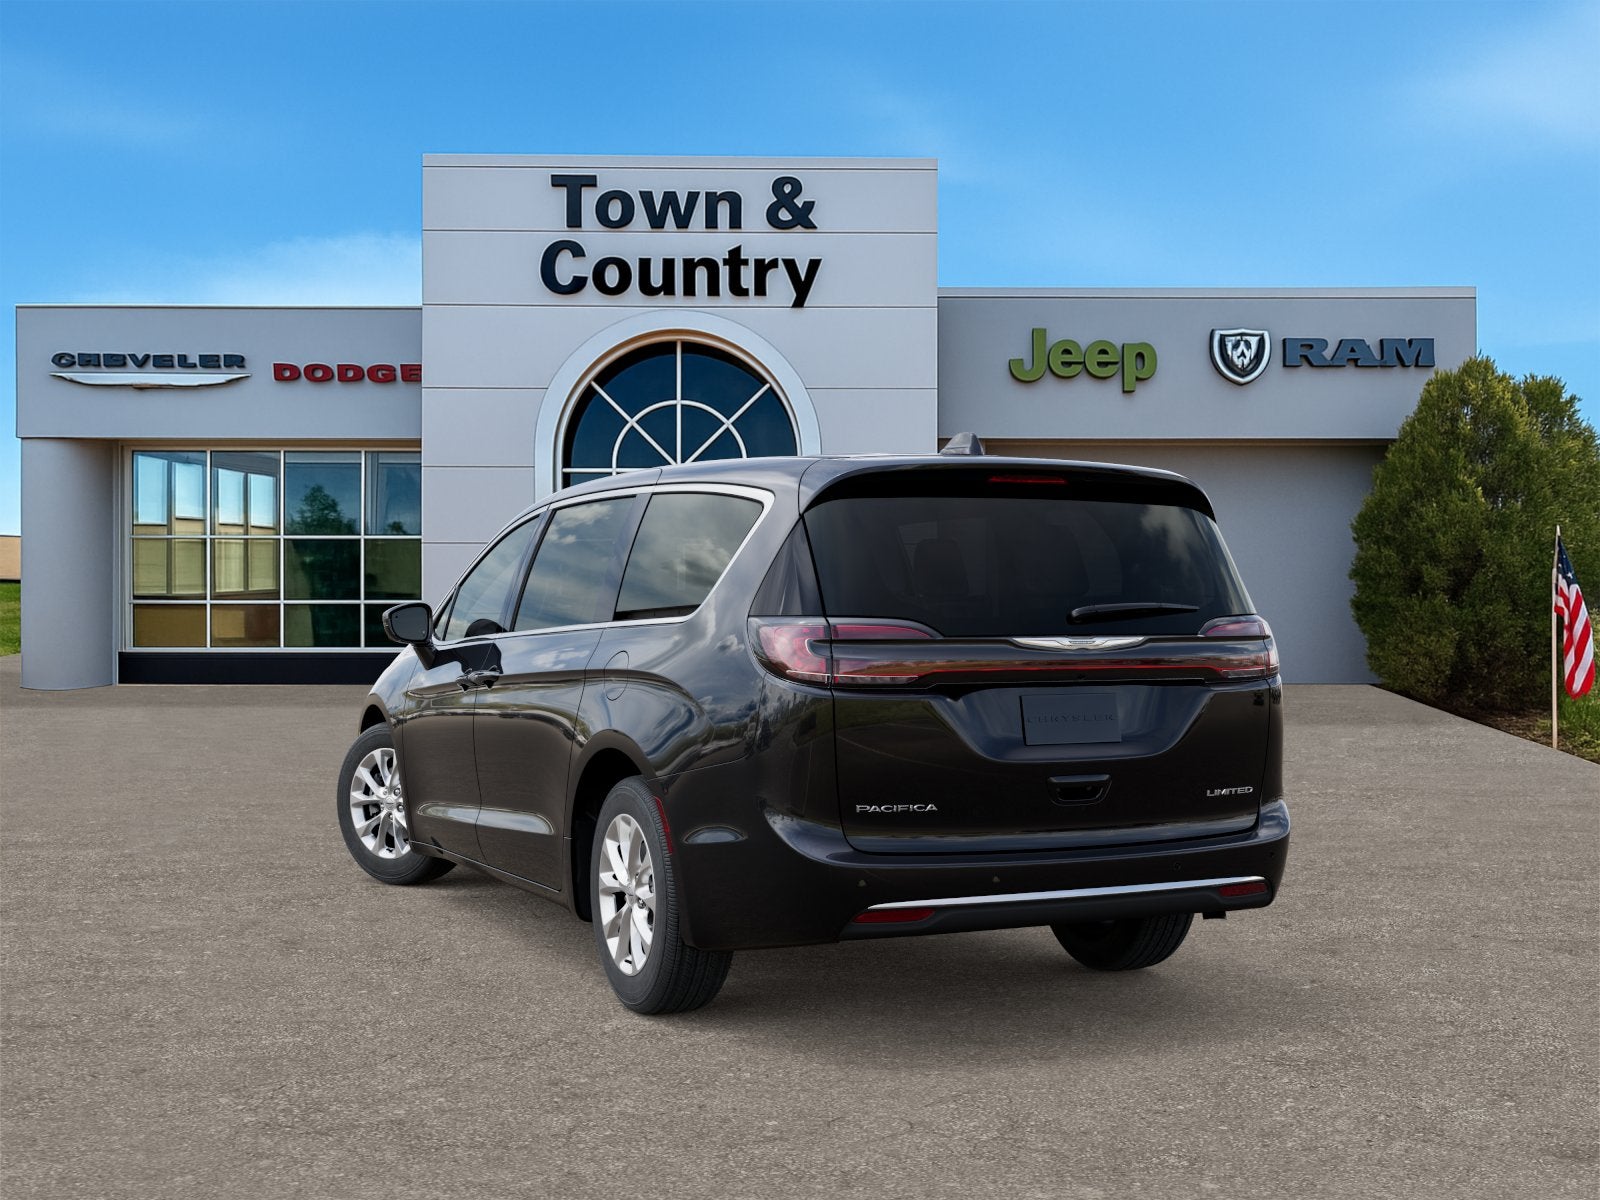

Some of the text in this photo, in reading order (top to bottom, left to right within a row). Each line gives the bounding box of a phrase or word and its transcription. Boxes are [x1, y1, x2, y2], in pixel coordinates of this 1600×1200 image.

[551, 174, 818, 230] Town &
[540, 239, 822, 308] Country
[1009, 328, 1157, 393] Jeep
[1283, 337, 1436, 368] RAM
[273, 363, 422, 383] DODGE
[1206, 786, 1254, 797] LIMITED
[855, 804, 938, 813] PACIFICA
